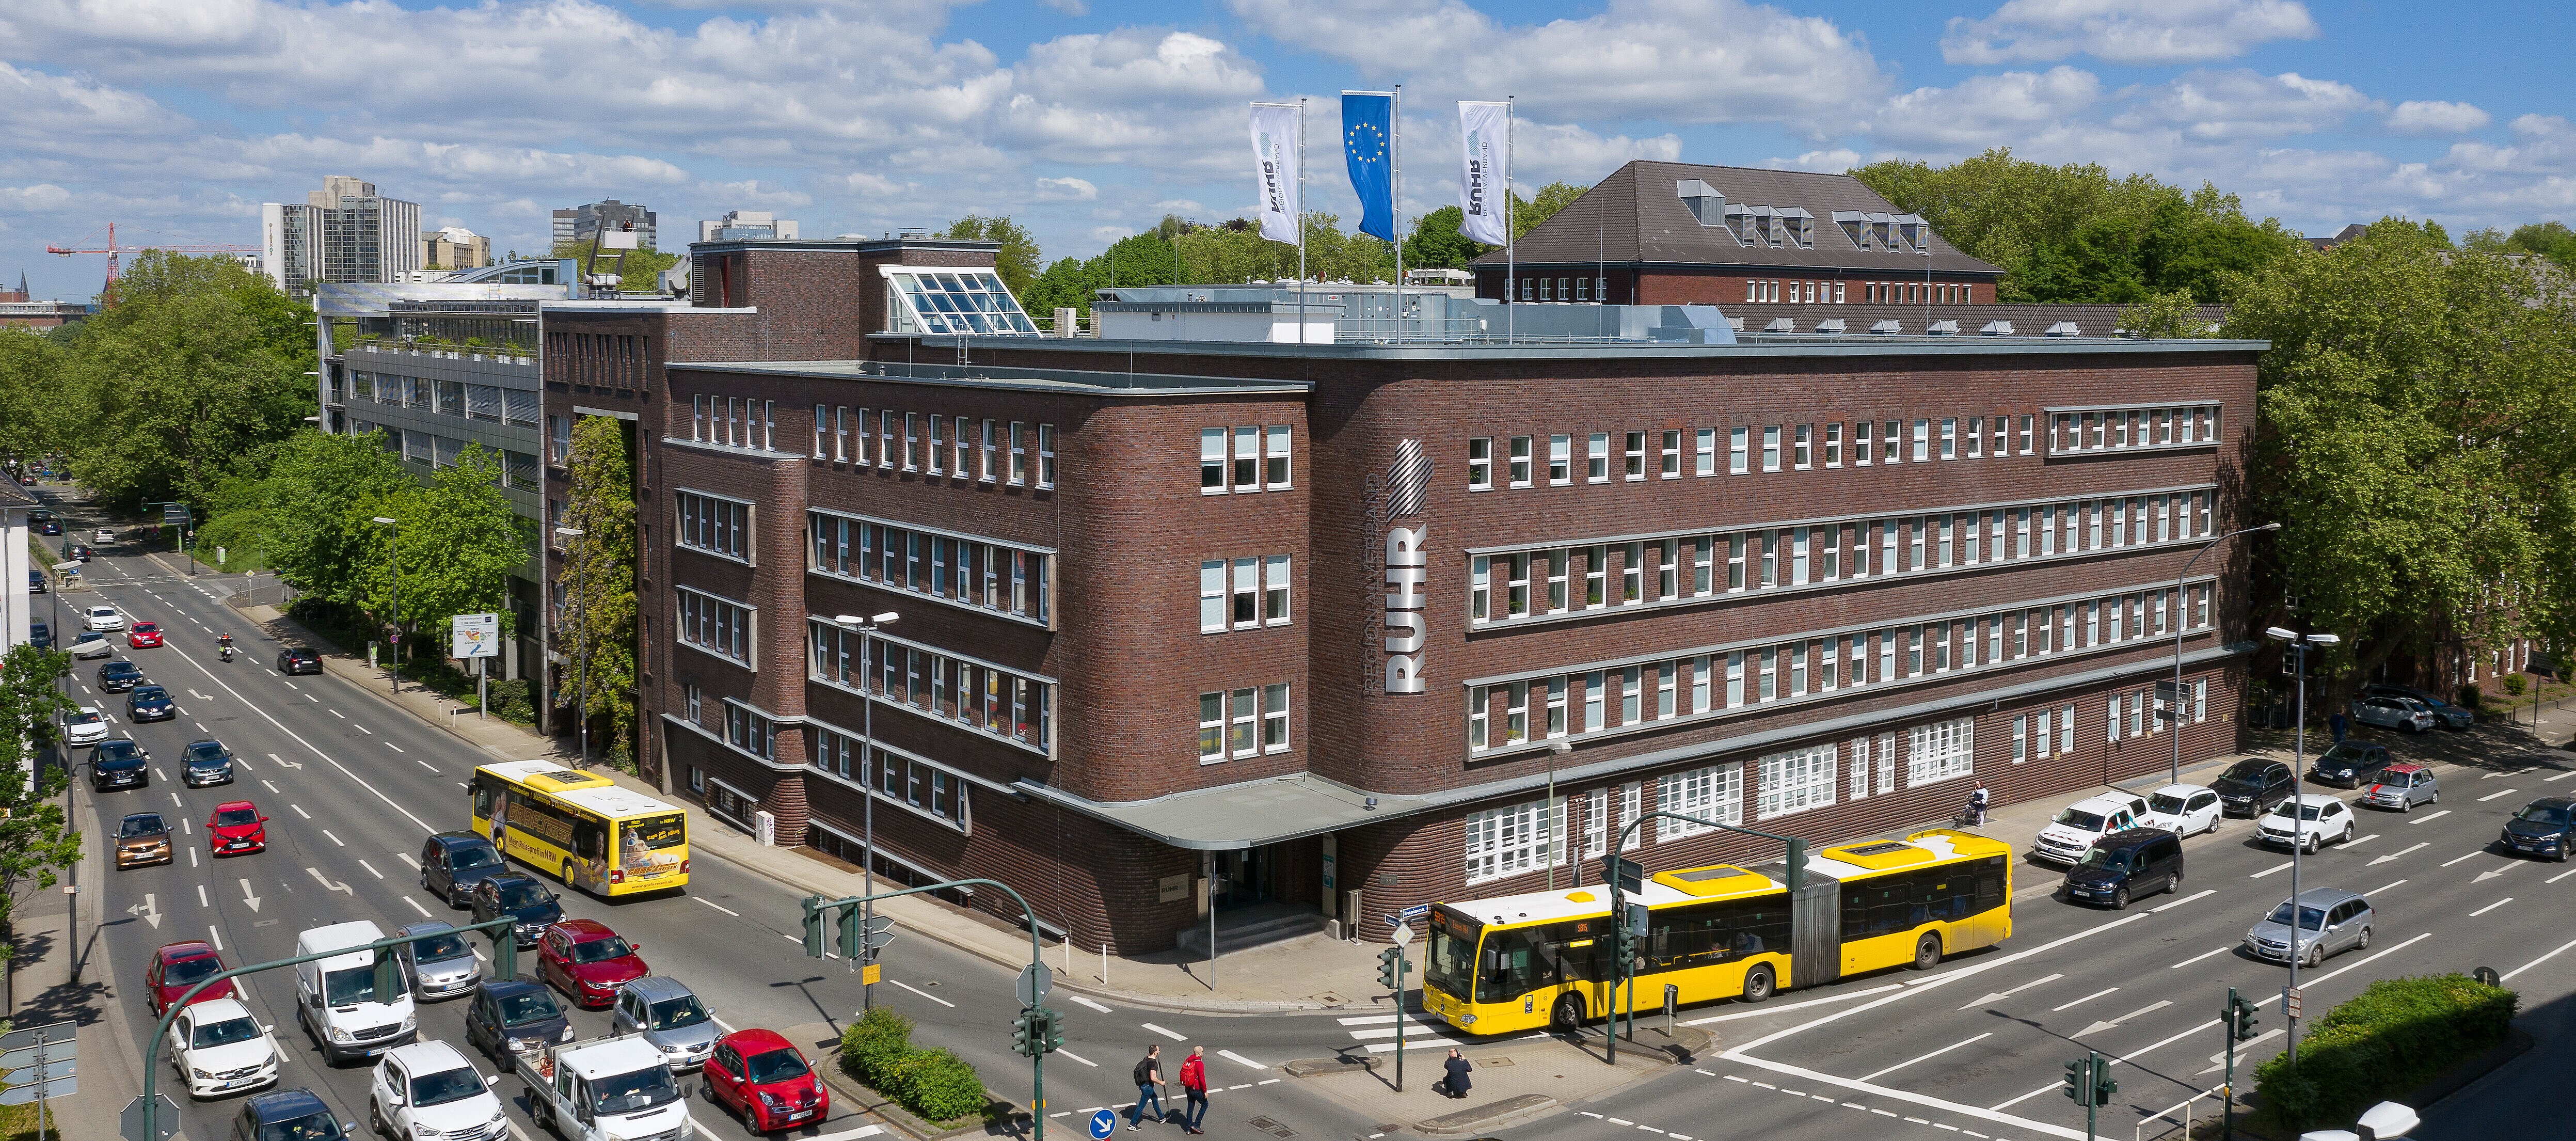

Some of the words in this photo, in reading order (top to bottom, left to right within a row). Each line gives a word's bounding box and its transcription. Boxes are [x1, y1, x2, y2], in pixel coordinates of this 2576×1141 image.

[1364, 472, 1380, 692] REGIONALVERBAND
[1386, 522, 1426, 693] RUHR
[545, 825, 571, 845] REISEN
[508, 835, 519, 847] Mein
[519, 841, 540, 856] Reiseprofi
[544, 850, 557, 863] NRW
[632, 880, 673, 889] www.grafs-reisen.de
[1162, 885, 1178, 893] RUHR
[1435, 910, 1445, 925] SB15
[1578, 923, 1587, 932] SB15
